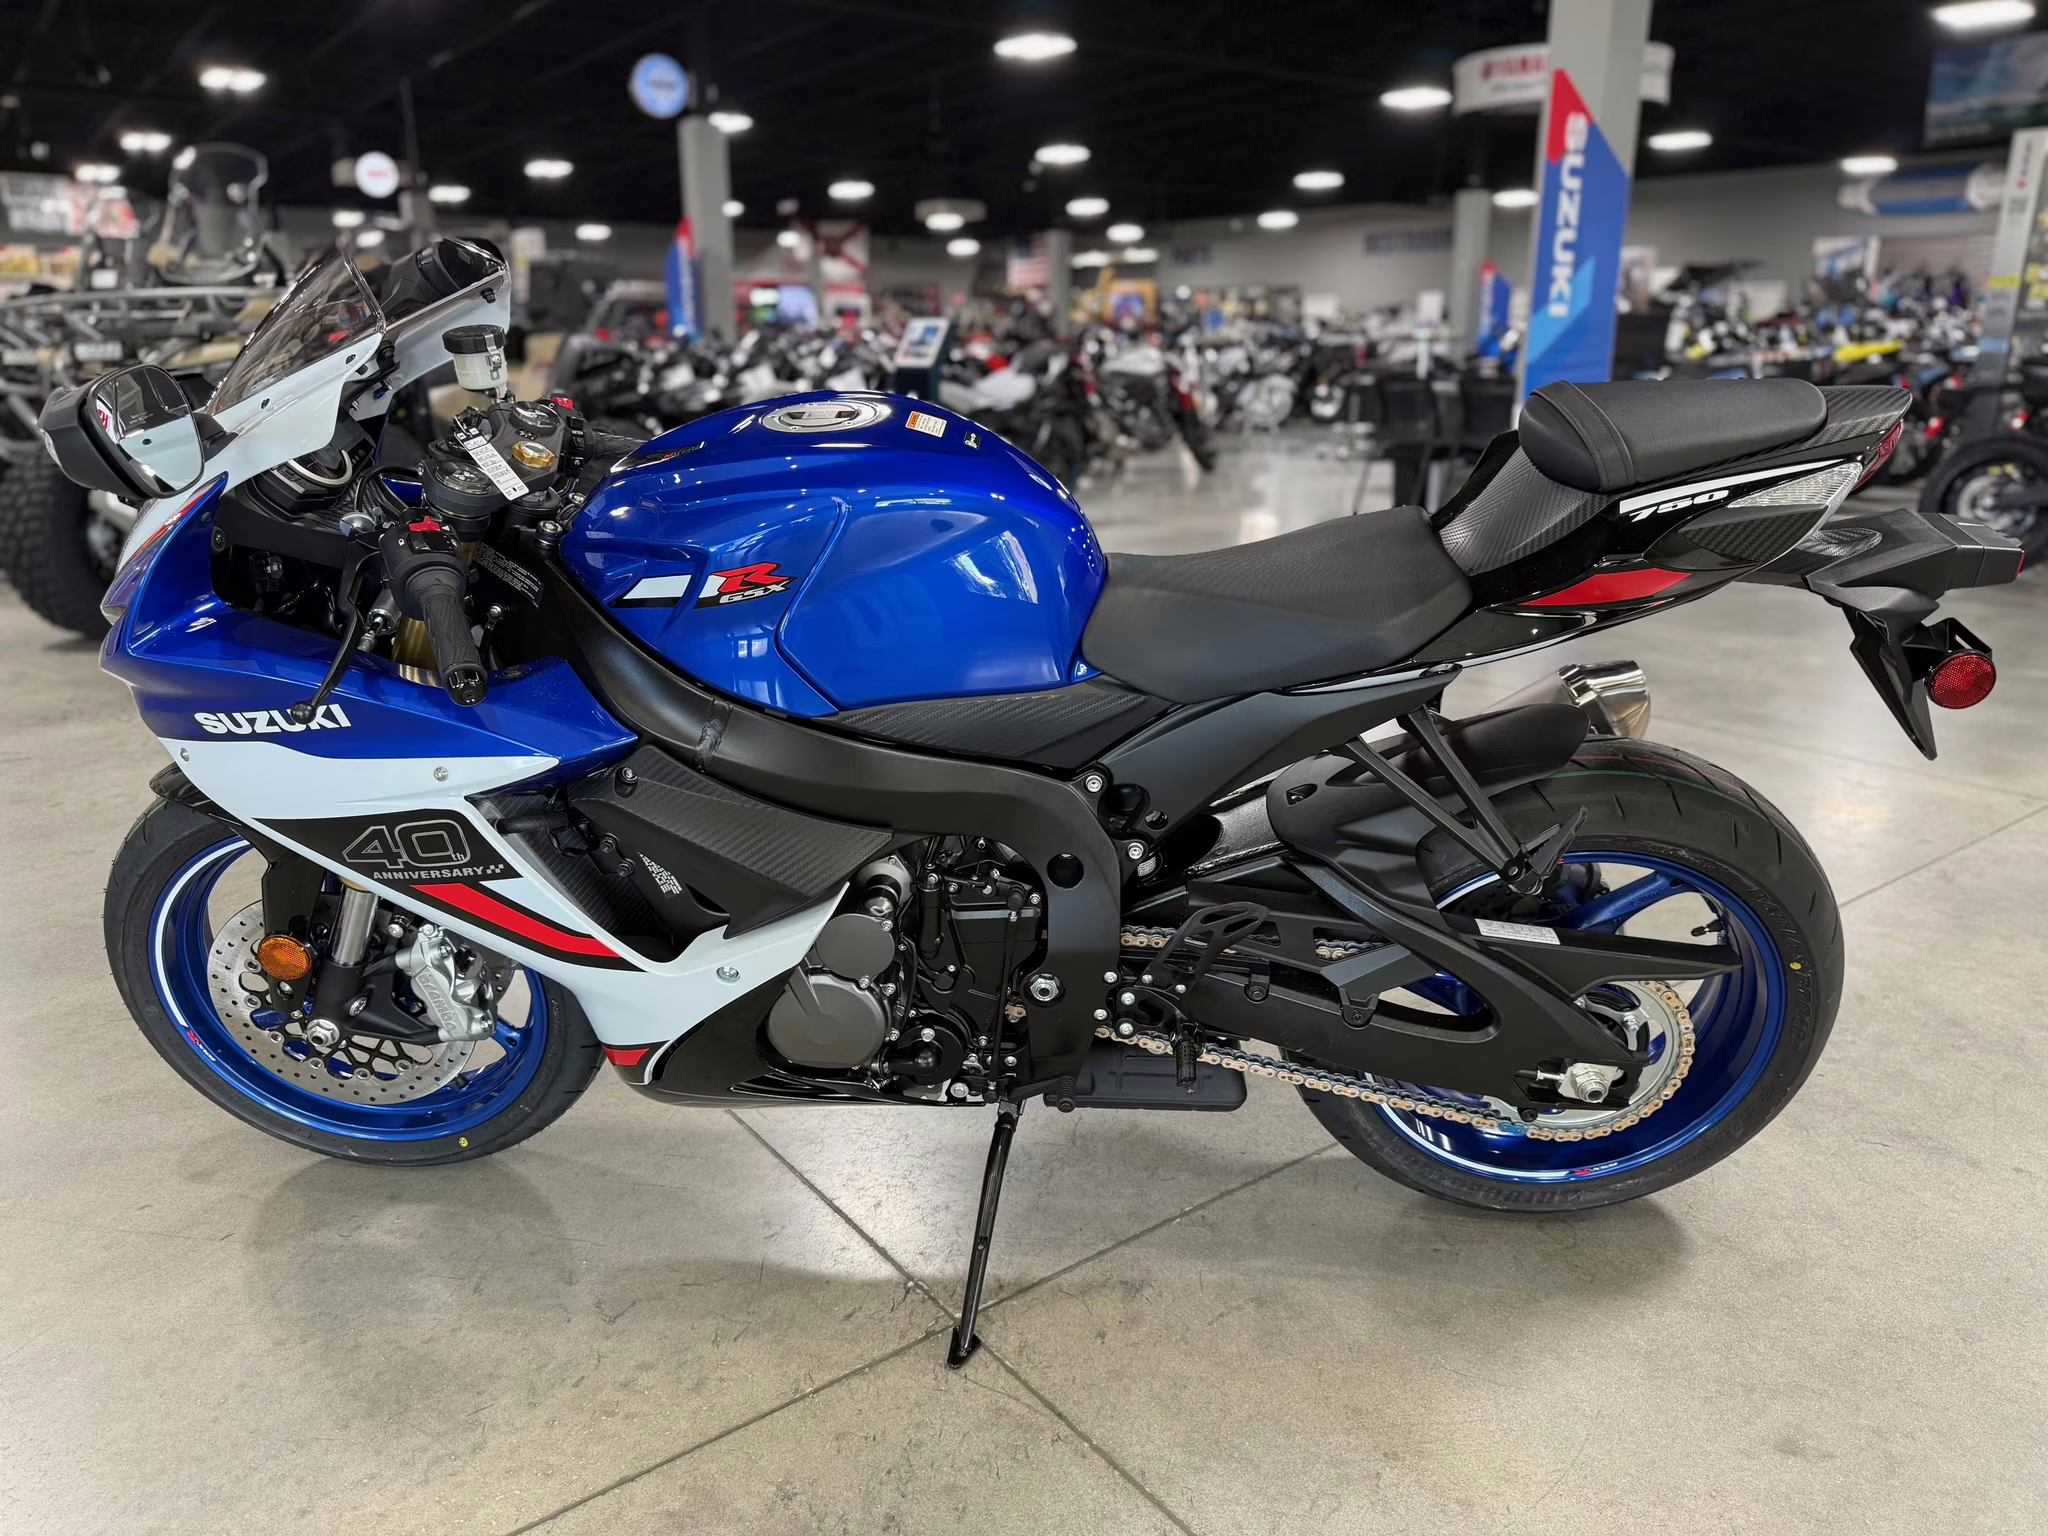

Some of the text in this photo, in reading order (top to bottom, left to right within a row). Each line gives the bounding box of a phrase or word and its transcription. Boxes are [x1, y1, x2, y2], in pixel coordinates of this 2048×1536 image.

[1548, 112, 1589, 319] SUZUKI
[1629, 489, 1730, 523] 750
[719, 581, 790, 604] GSX
[194, 703, 352, 735] SUZUKI
[373, 866, 484, 880] ANNIVERSARY
[418, 971, 457, 1032] brembo
